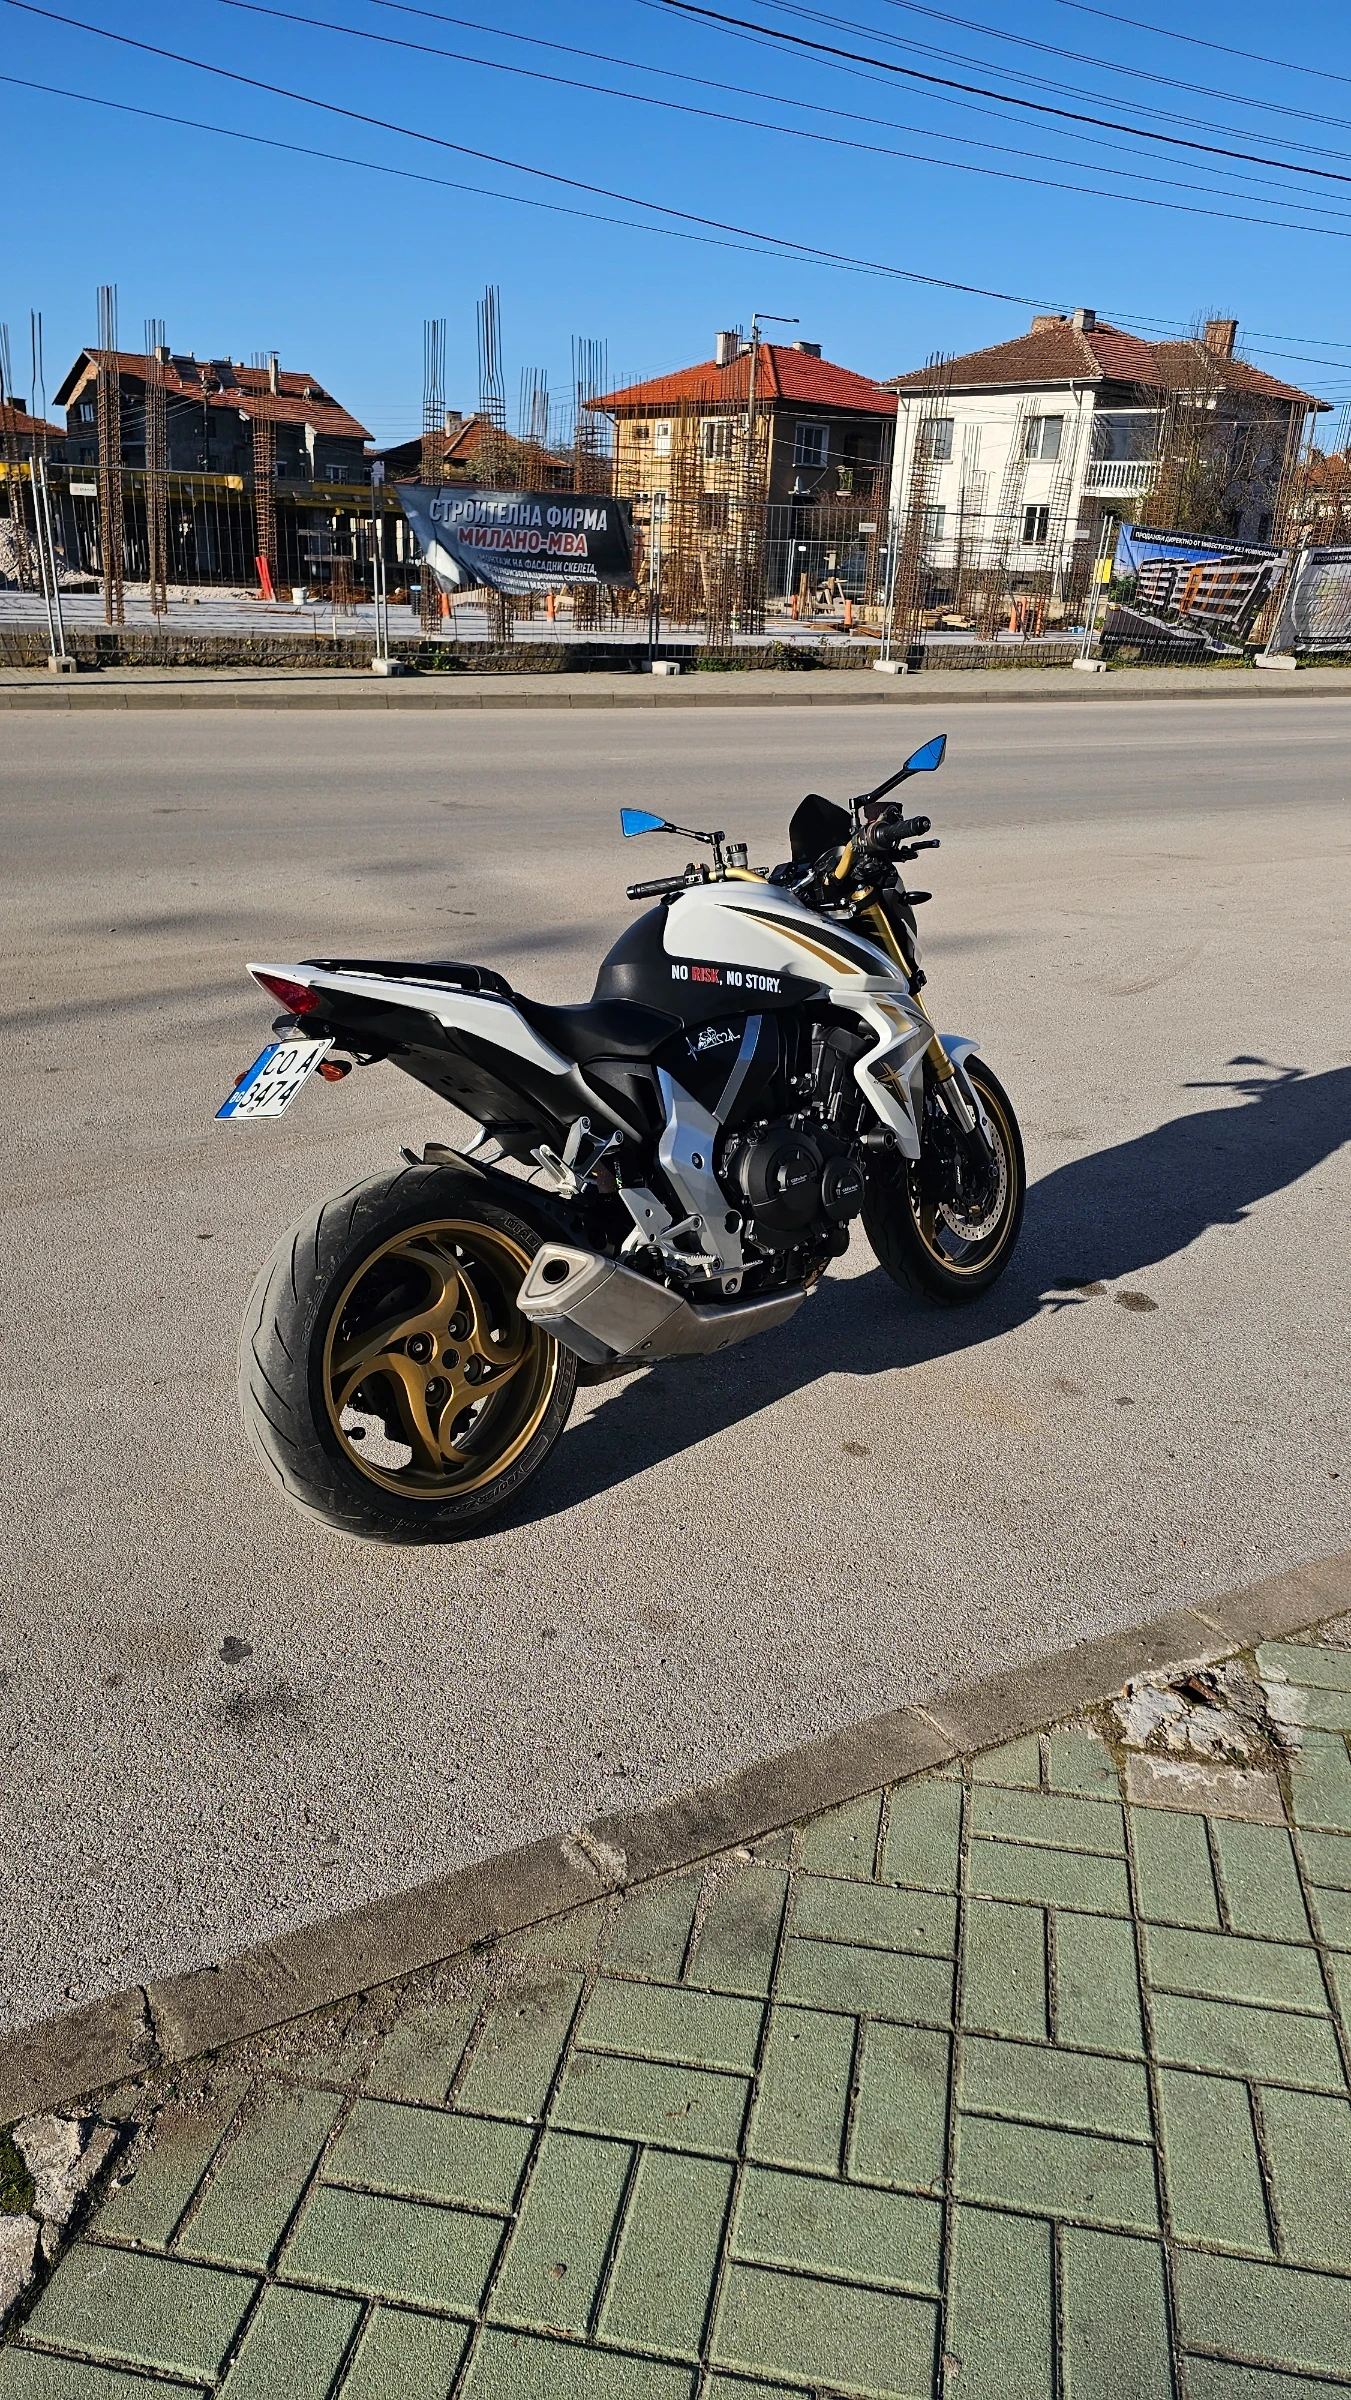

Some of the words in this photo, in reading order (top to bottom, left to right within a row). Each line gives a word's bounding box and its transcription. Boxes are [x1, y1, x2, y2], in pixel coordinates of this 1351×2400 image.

[429, 499, 542, 528] СТРОИТЕЛНА
[546, 505, 608, 531] ФИРМА
[457, 526, 588, 557] МИЛАНО-МВА
[512, 558, 523, 569] НА
[524, 559, 562, 573] ФАСАДНИ
[563, 562, 598, 575] СКЕЛЕТА,
[671, 965, 688, 980] NO
[691, 966, 723, 985] RISK,
[726, 970, 742, 987] NO
[745, 973, 782, 993] STORY.
[262, 1049, 298, 1076] CO
[295, 1047, 319, 1074] A
[229, 1091, 245, 1104] BG
[238, 1080, 300, 1108] 3474
[504, 1217, 541, 1253] DIABL
